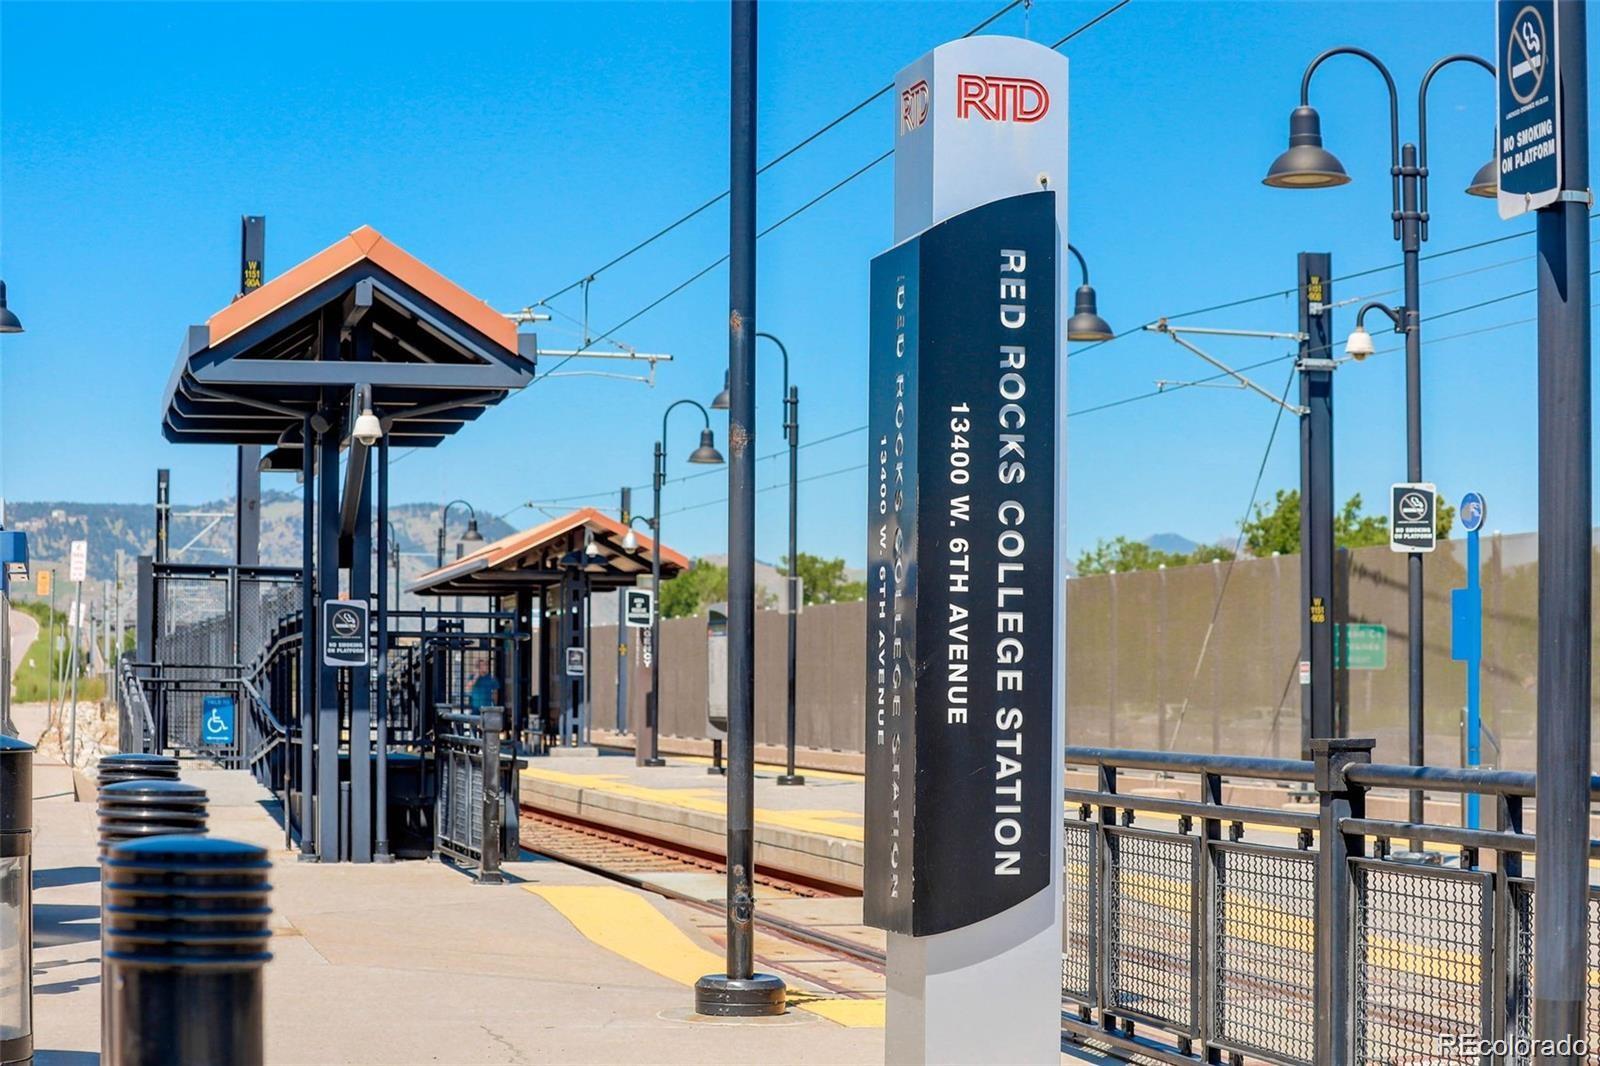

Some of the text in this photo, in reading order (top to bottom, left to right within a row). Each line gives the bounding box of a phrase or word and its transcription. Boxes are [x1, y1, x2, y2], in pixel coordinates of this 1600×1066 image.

[901, 79, 929, 136] RTD
[957, 74, 1050, 122] RTD
[1503, 119, 1553, 154] NO SMOKING
[1502, 138, 1555, 174] ON PLATFORM
[879, 435, 887, 515] 13400
[895, 373, 904, 512] ROCKS
[879, 524, 887, 556] W.
[947, 402, 971, 724] 13400 W. 6TH AVENUE
[994, 249, 1027, 876] RED ROCKS COLLEGE STATION
[892, 527, 904, 717] COLLEGE
[877, 629, 886, 745] AVENUE
[891, 733, 900, 898] STATION
